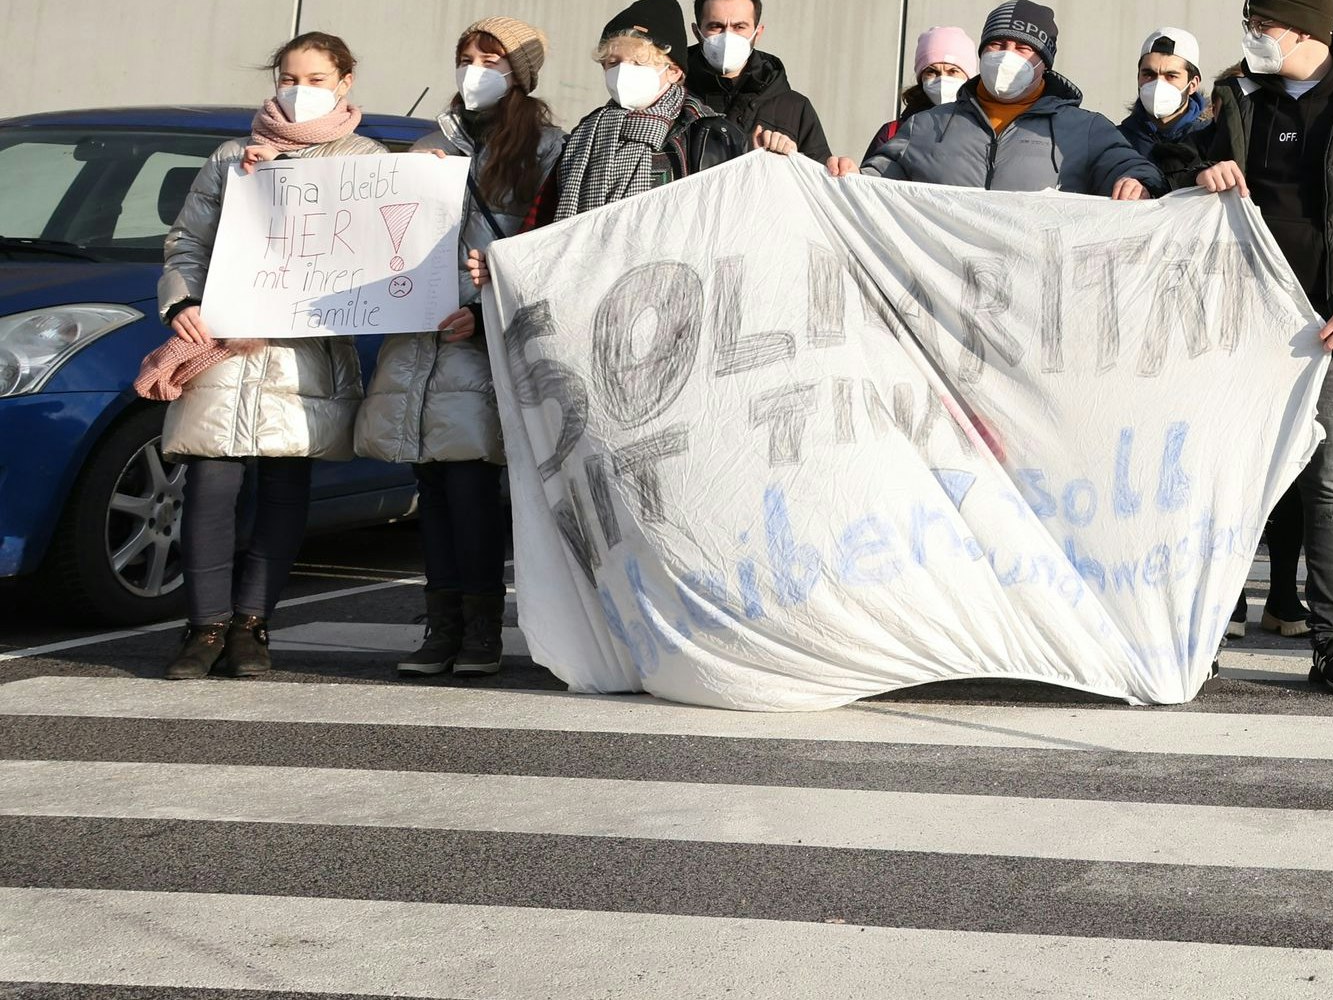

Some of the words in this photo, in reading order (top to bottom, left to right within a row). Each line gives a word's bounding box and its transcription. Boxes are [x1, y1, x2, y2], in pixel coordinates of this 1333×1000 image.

[1011, 20, 1057, 55] SPOR
[257, 167, 319, 207] Tina
[340, 158, 400, 202] bleibt
[264, 209, 356, 260] HIER
[253, 254, 291, 290] mit
[303, 254, 365, 293] ihrer
[291, 288, 381, 330] Familie
